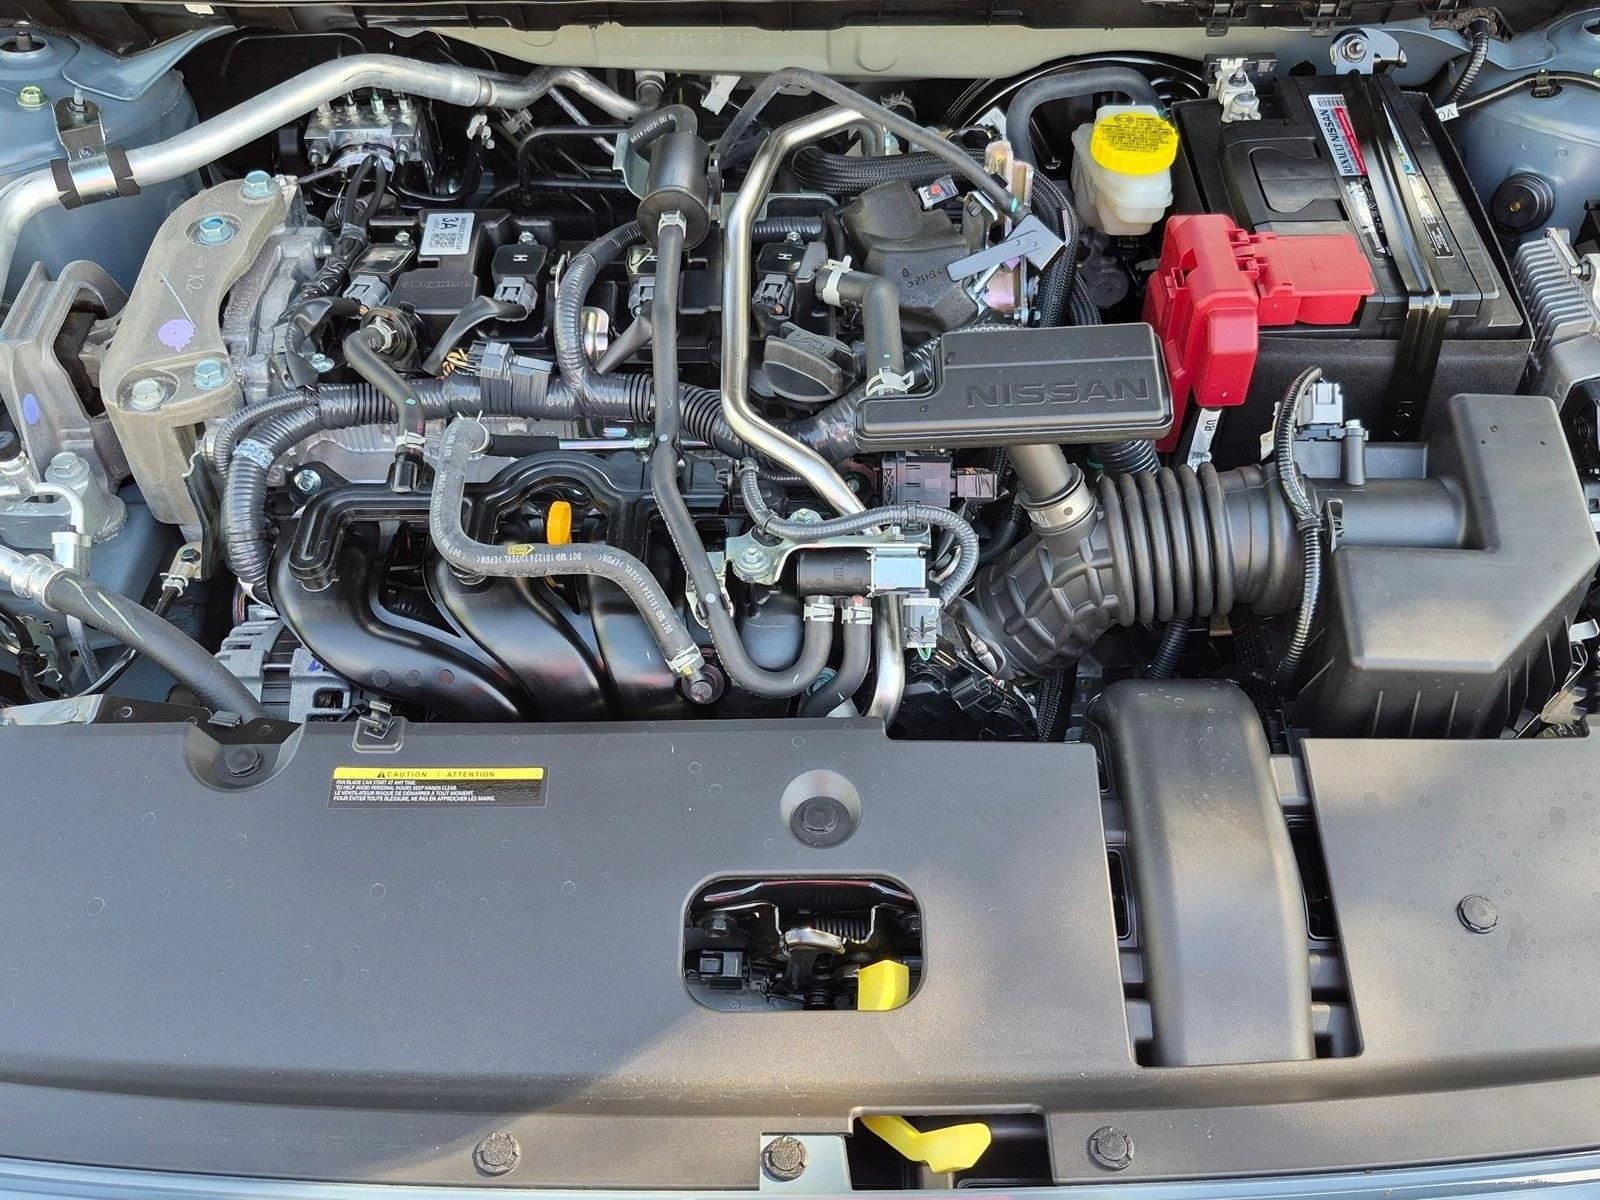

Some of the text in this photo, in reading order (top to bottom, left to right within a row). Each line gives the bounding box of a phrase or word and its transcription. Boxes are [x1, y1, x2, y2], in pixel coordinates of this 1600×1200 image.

[1319, 109, 1354, 174] RENAULT NISSAN
[440, 217, 459, 230] 3A
[967, 377, 1150, 408] NISSAN
[643, 586, 659, 609] 101224
